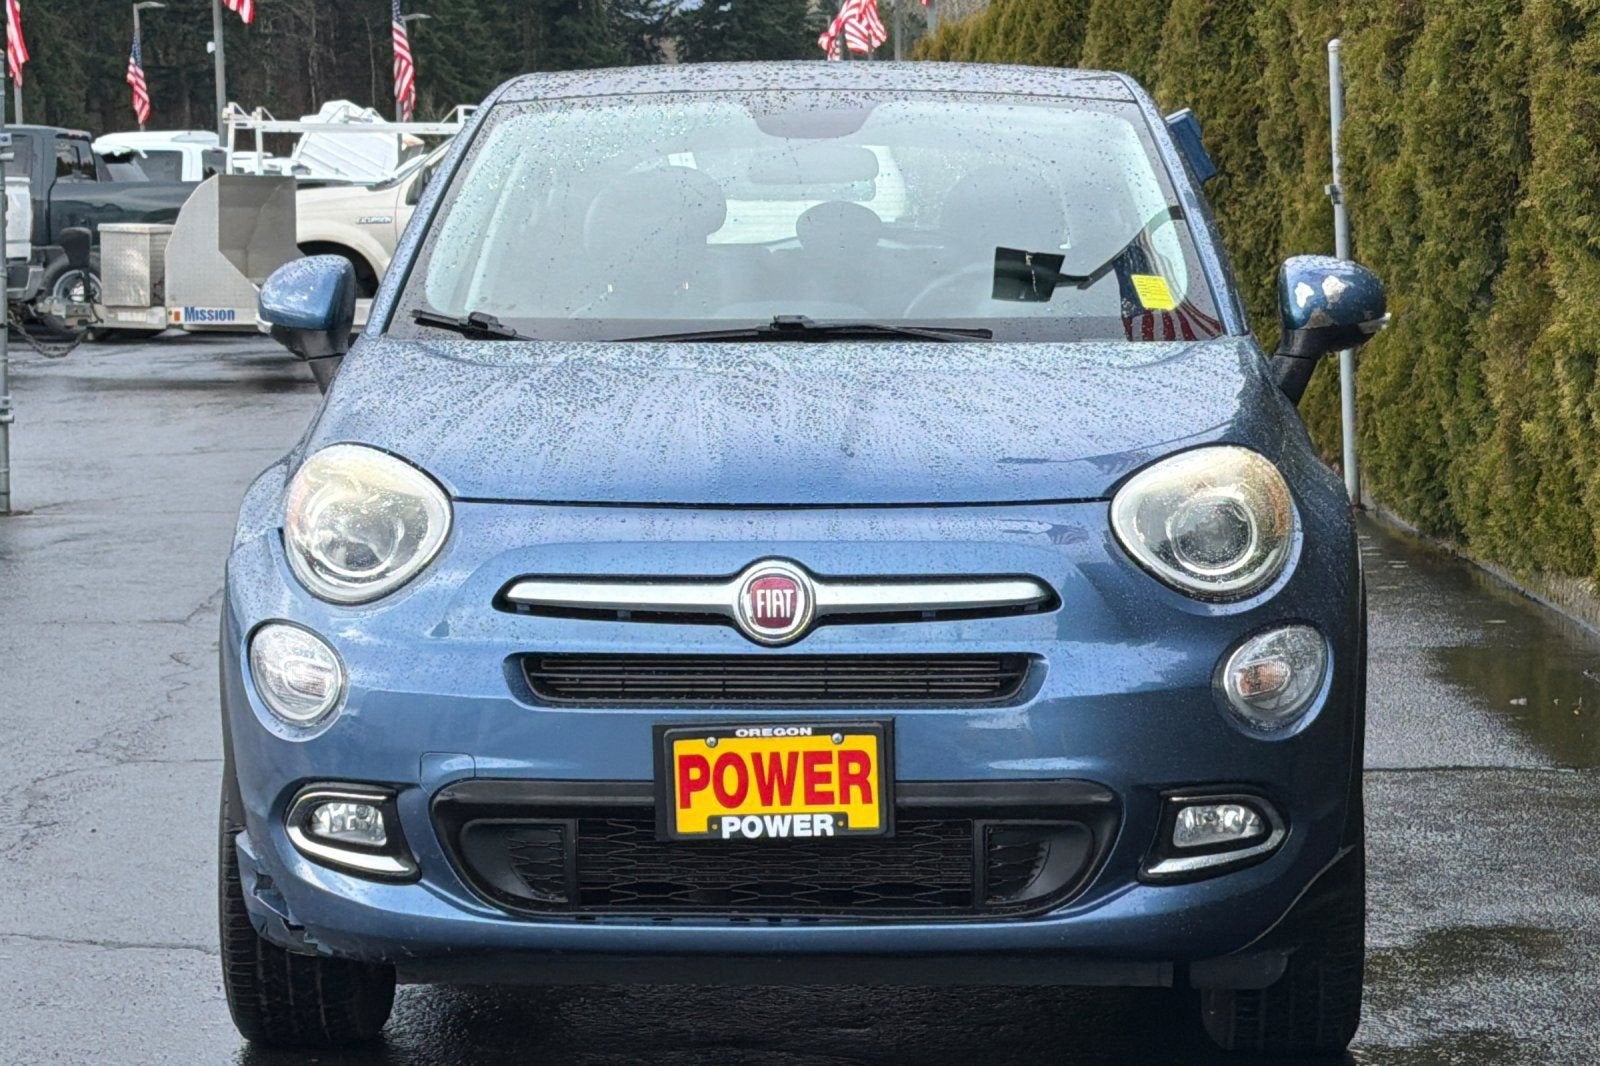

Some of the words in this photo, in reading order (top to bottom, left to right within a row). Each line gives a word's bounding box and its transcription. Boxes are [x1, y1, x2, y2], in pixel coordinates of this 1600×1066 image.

[184, 306, 235, 321] Mission
[756, 588, 795, 618] FIAT
[735, 727, 813, 737] OREGON
[678, 750, 873, 809] POWER
[721, 814, 834, 839] POWER
